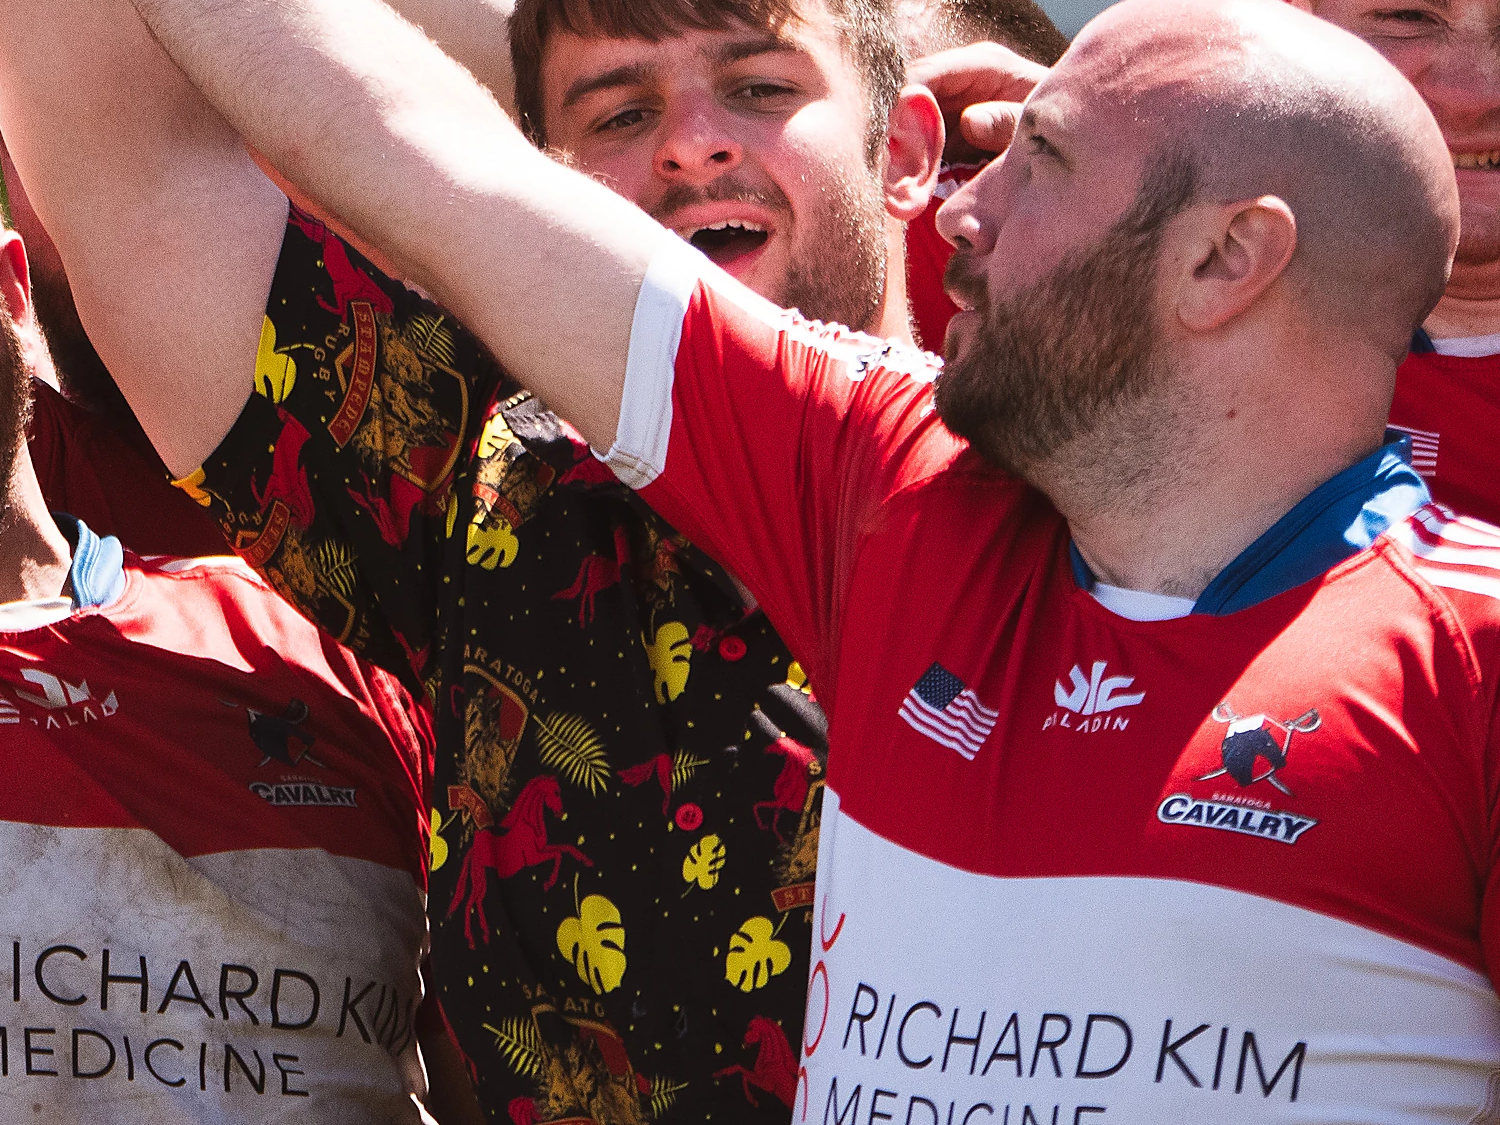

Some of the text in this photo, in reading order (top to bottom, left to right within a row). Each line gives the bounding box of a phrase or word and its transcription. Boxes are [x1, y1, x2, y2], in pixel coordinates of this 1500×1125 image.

[314, 323, 350, 402] RUGBY
[337, 312, 372, 434] STAMPEDE
[223, 511, 263, 535] RUGB
[462, 643, 540, 705] ARATOGA
[249, 783, 357, 807] CAVALRY
[1159, 795, 1312, 842] CAVALRY
[336, 976, 413, 1057] KIM
[522, 982, 605, 1018] SAATO
[843, 981, 1308, 1103] RICHARD KIM
